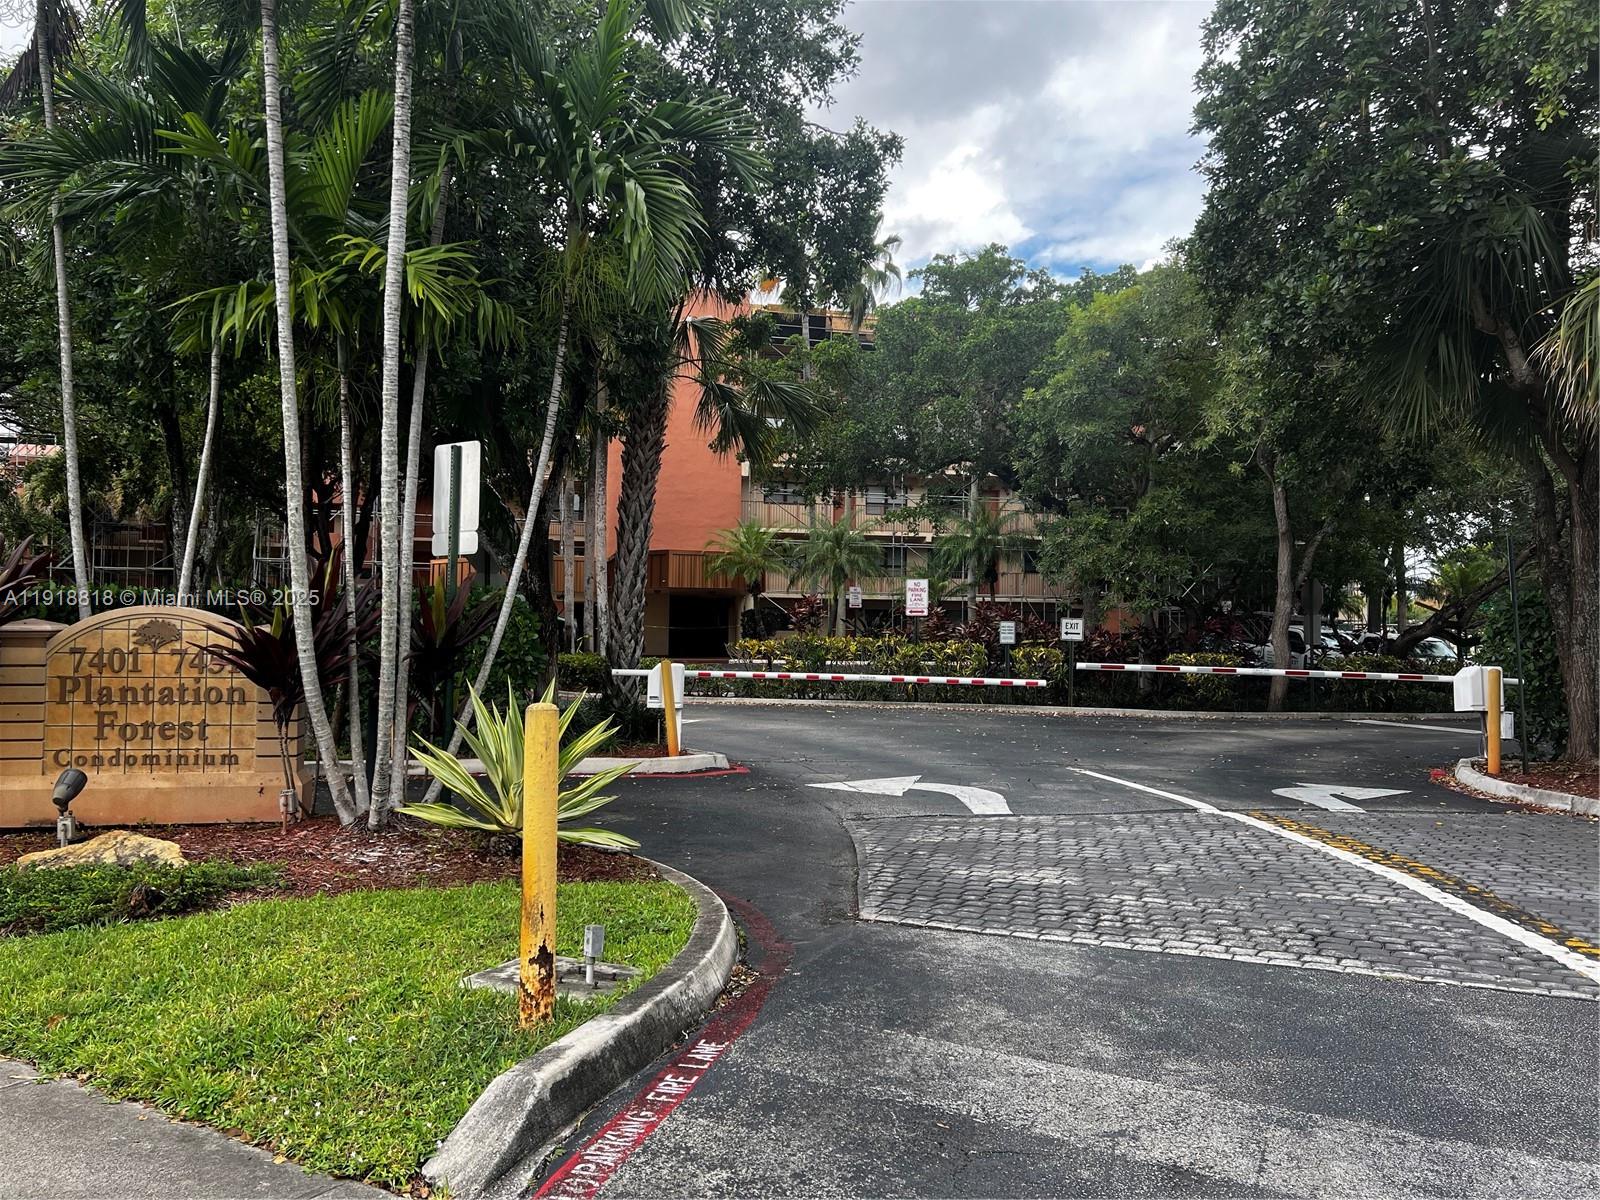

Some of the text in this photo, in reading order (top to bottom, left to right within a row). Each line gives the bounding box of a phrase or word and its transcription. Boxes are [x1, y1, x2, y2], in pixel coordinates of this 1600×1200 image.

[1065, 622, 1079, 630] EXIT
[69, 647, 241, 674] 7401 745
[56, 675, 247, 705] Plantation
[94, 710, 209, 742] Forest
[53, 749, 240, 768] Condominium
[646, 1073, 699, 1103] FIRE
[677, 1038, 728, 1070] LANE
